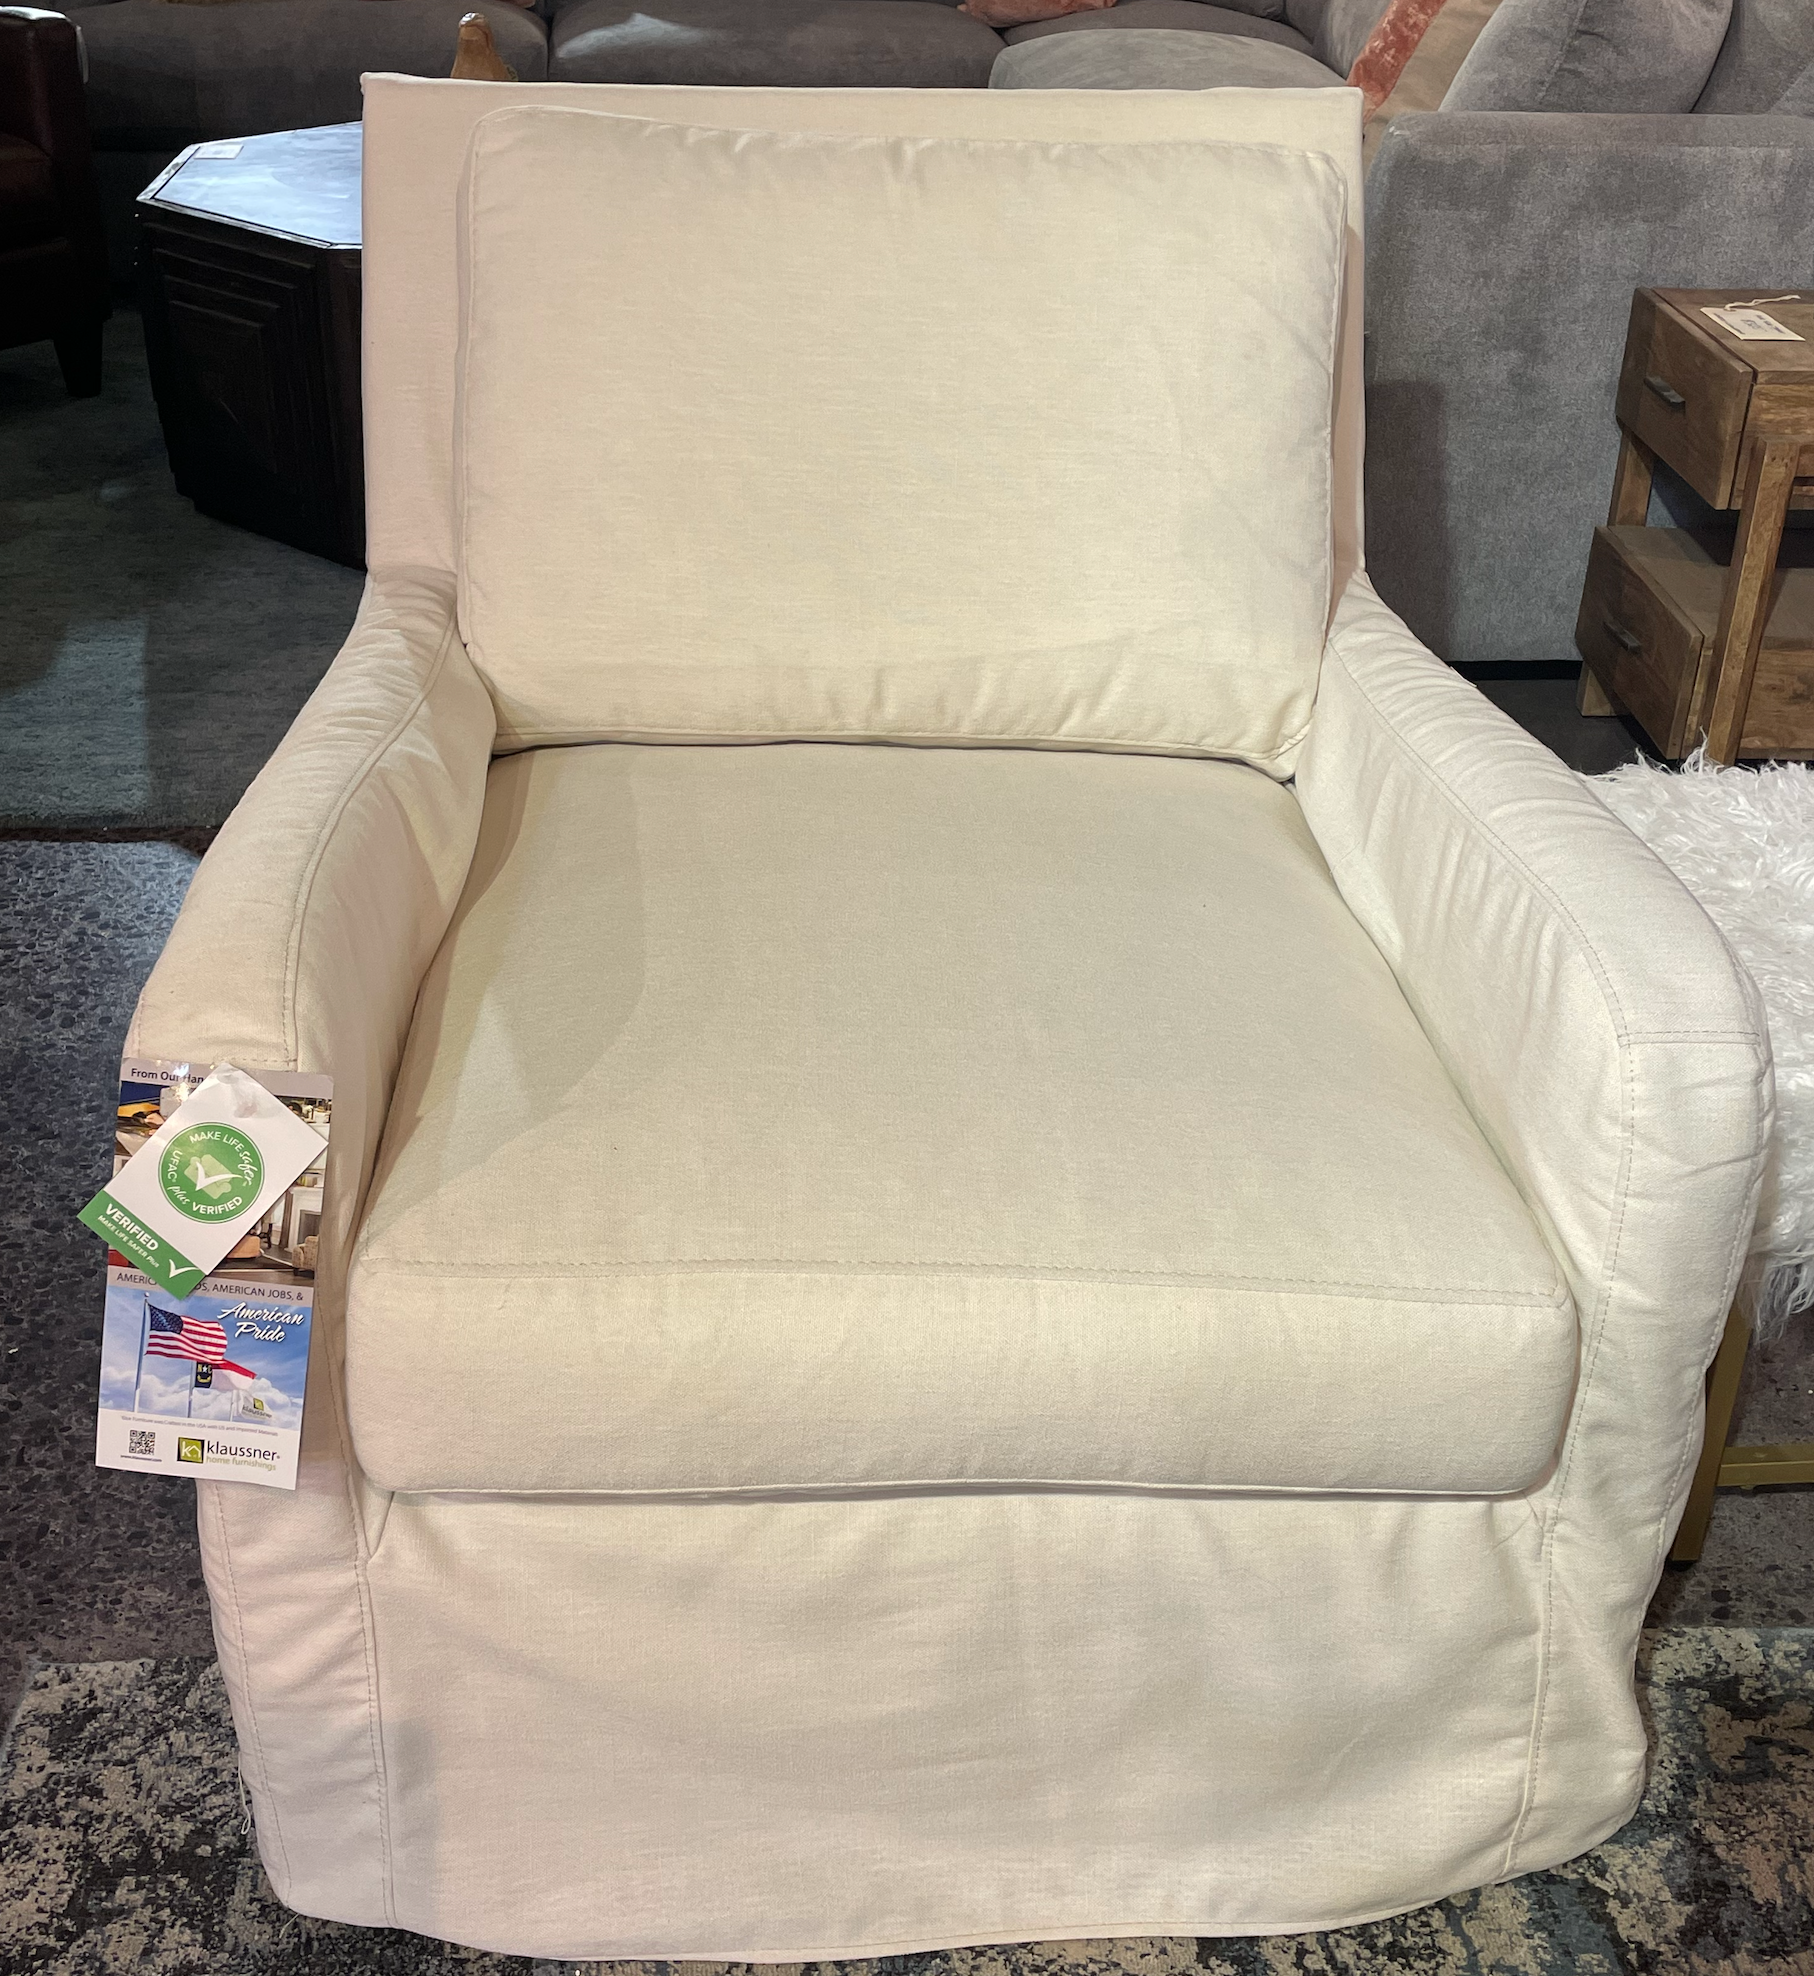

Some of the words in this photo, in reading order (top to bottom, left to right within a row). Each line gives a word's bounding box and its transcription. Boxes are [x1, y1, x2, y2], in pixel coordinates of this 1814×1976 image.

[131, 1068, 157, 1079] From
[161, 1071, 180, 1082] Our
[184, 1074, 204, 1084] Han
[189, 1131, 221, 1143] MAKE
[222, 1134, 245, 1153] LIFE
[167, 1185, 191, 1205] plus
[192, 1196, 243, 1215] VERIFIED
[97, 1215, 117, 1232] MAKE
[114, 1229, 129, 1243] LIFE
[127, 1240, 148, 1258] SAFER
[105, 1203, 159, 1251] VERIFIED
[117, 1272, 157, 1286] AMERIC
[212, 1284, 265, 1297] AMERICAN
[267, 1290, 294, 1301] JOBS,
[296, 1292, 304, 1301] &
[217, 1302, 305, 1325] American
[234, 1321, 286, 1343] Pride
[207, 1440, 277, 1461] klaussner
[206, 1455, 230, 1465] home
[231, 1457, 276, 1471] furnishings
